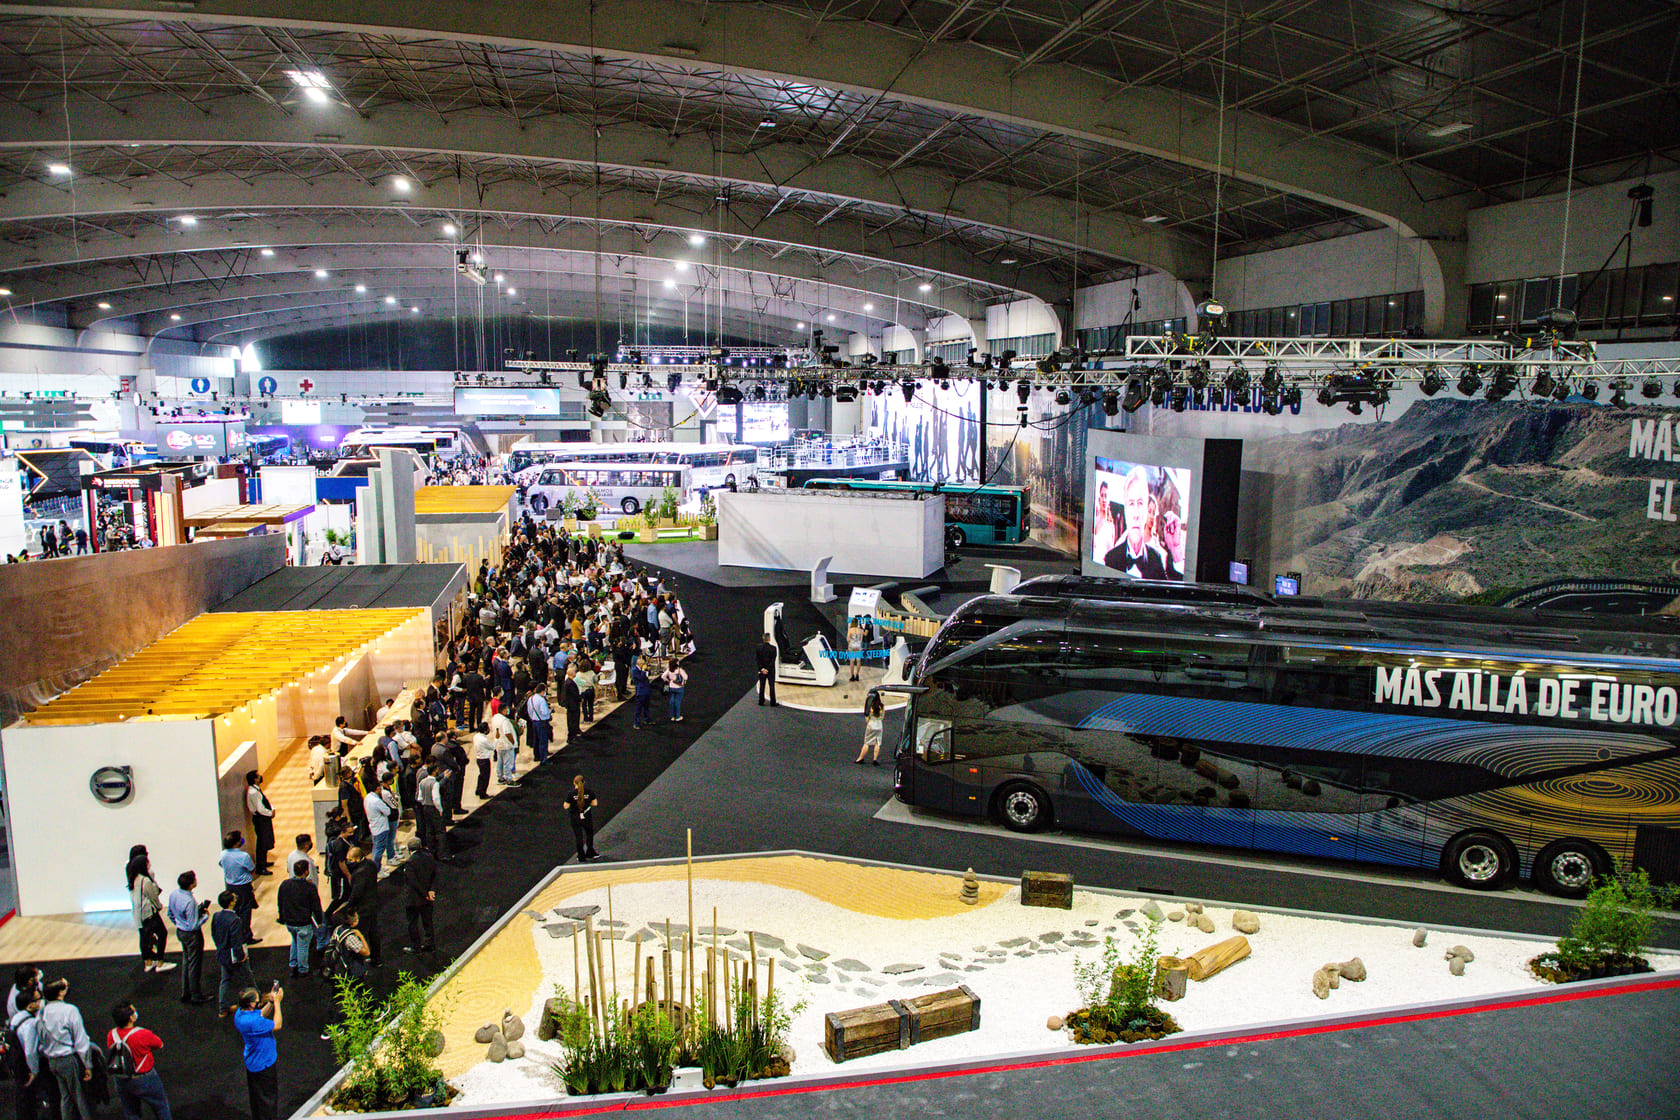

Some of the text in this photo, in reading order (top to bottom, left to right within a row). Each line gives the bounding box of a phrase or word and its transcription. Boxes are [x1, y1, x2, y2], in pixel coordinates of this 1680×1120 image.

[1646, 478, 1677, 522] EL
[1375, 662, 1678, 727] MÁS ALLÁ DE EURO
